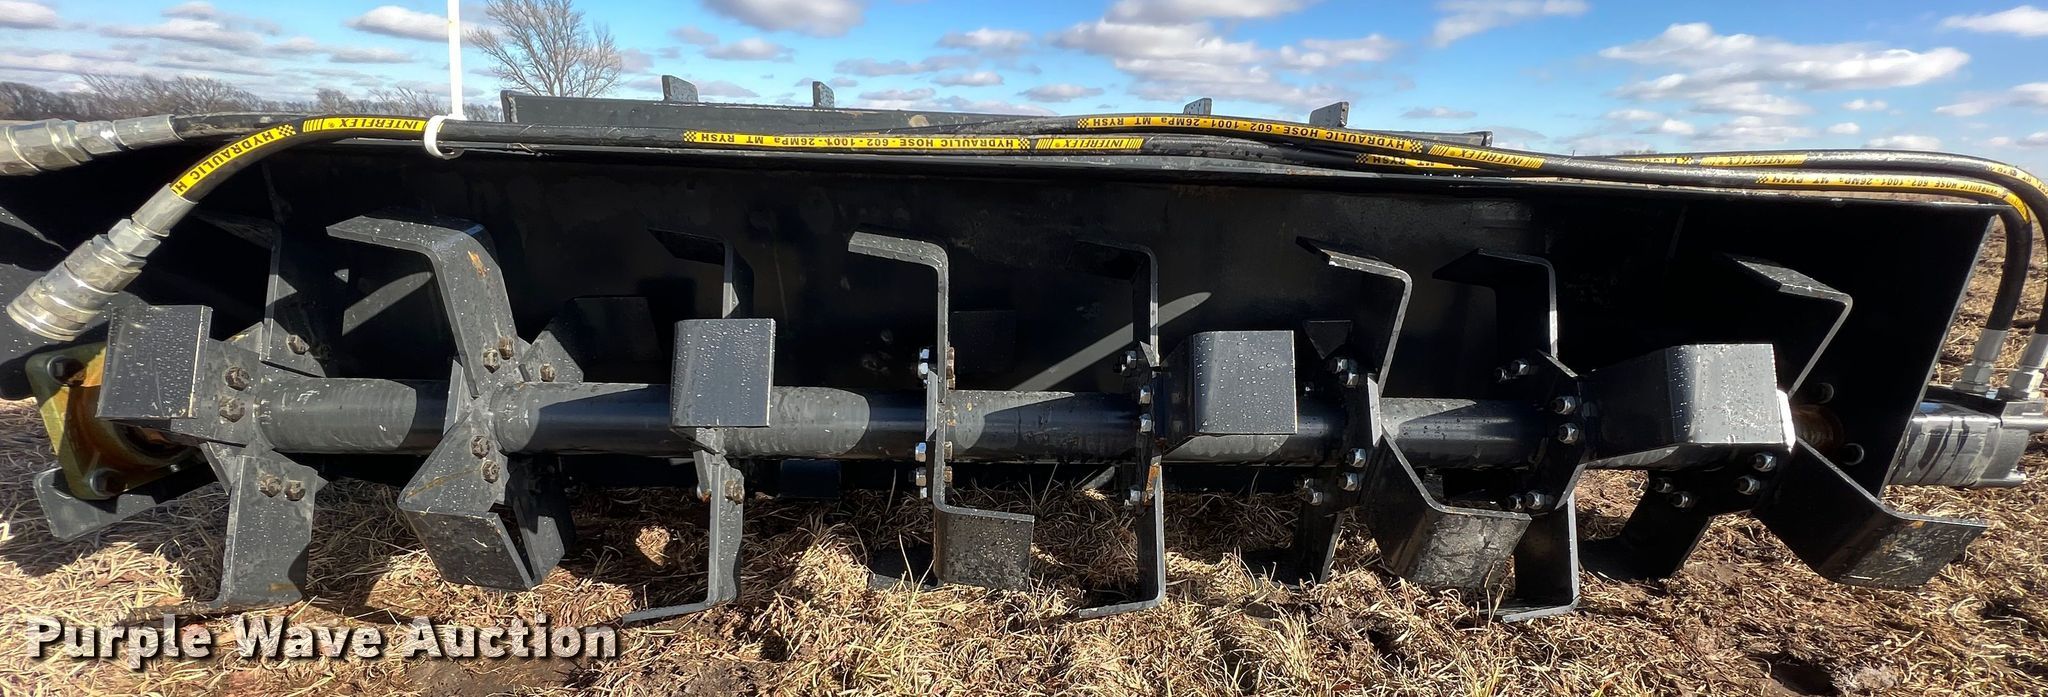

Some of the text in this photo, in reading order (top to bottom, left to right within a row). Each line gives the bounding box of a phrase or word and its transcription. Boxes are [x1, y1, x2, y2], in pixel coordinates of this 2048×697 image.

[340, 118, 418, 130] INTERFLEX
[1093, 117, 1124, 126] RYSH
[1134, 117, 1151, 125] MT
[701, 133, 735, 143] RYSH
[746, 136, 763, 144] MT
[941, 138, 1013, 147] HYDRAULIC
[1064, 138, 1122, 148] INTERFLEX
[1326, 131, 1405, 149] HYDRAULIC
[190, 131, 275, 180] HYDRAULIC
[1461, 149, 1523, 166] INTERFLEX
